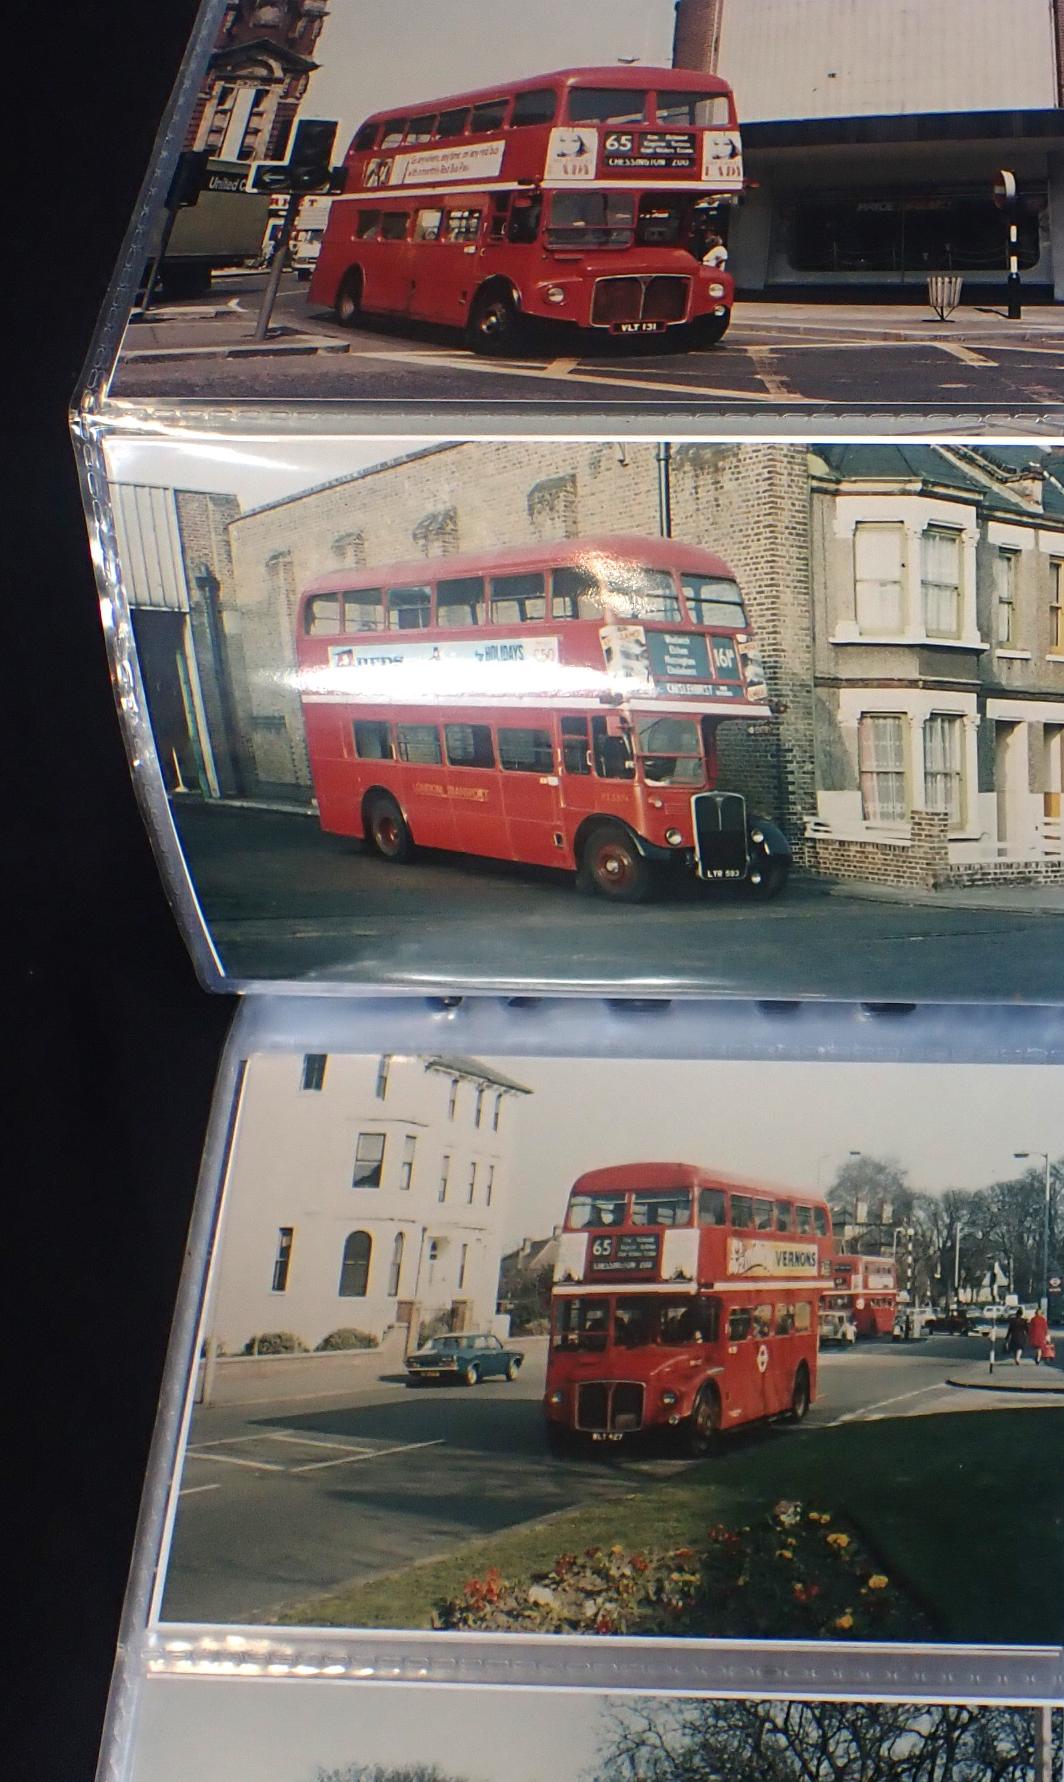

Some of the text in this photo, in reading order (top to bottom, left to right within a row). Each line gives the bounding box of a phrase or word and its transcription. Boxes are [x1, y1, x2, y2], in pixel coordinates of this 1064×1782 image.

[605, 135, 632, 150] 65
[208, 176, 238, 191] United
[621, 323, 641, 332] VLT
[592, 1239, 612, 1256] 65
[775, 1249, 816, 1267] VERNONS
